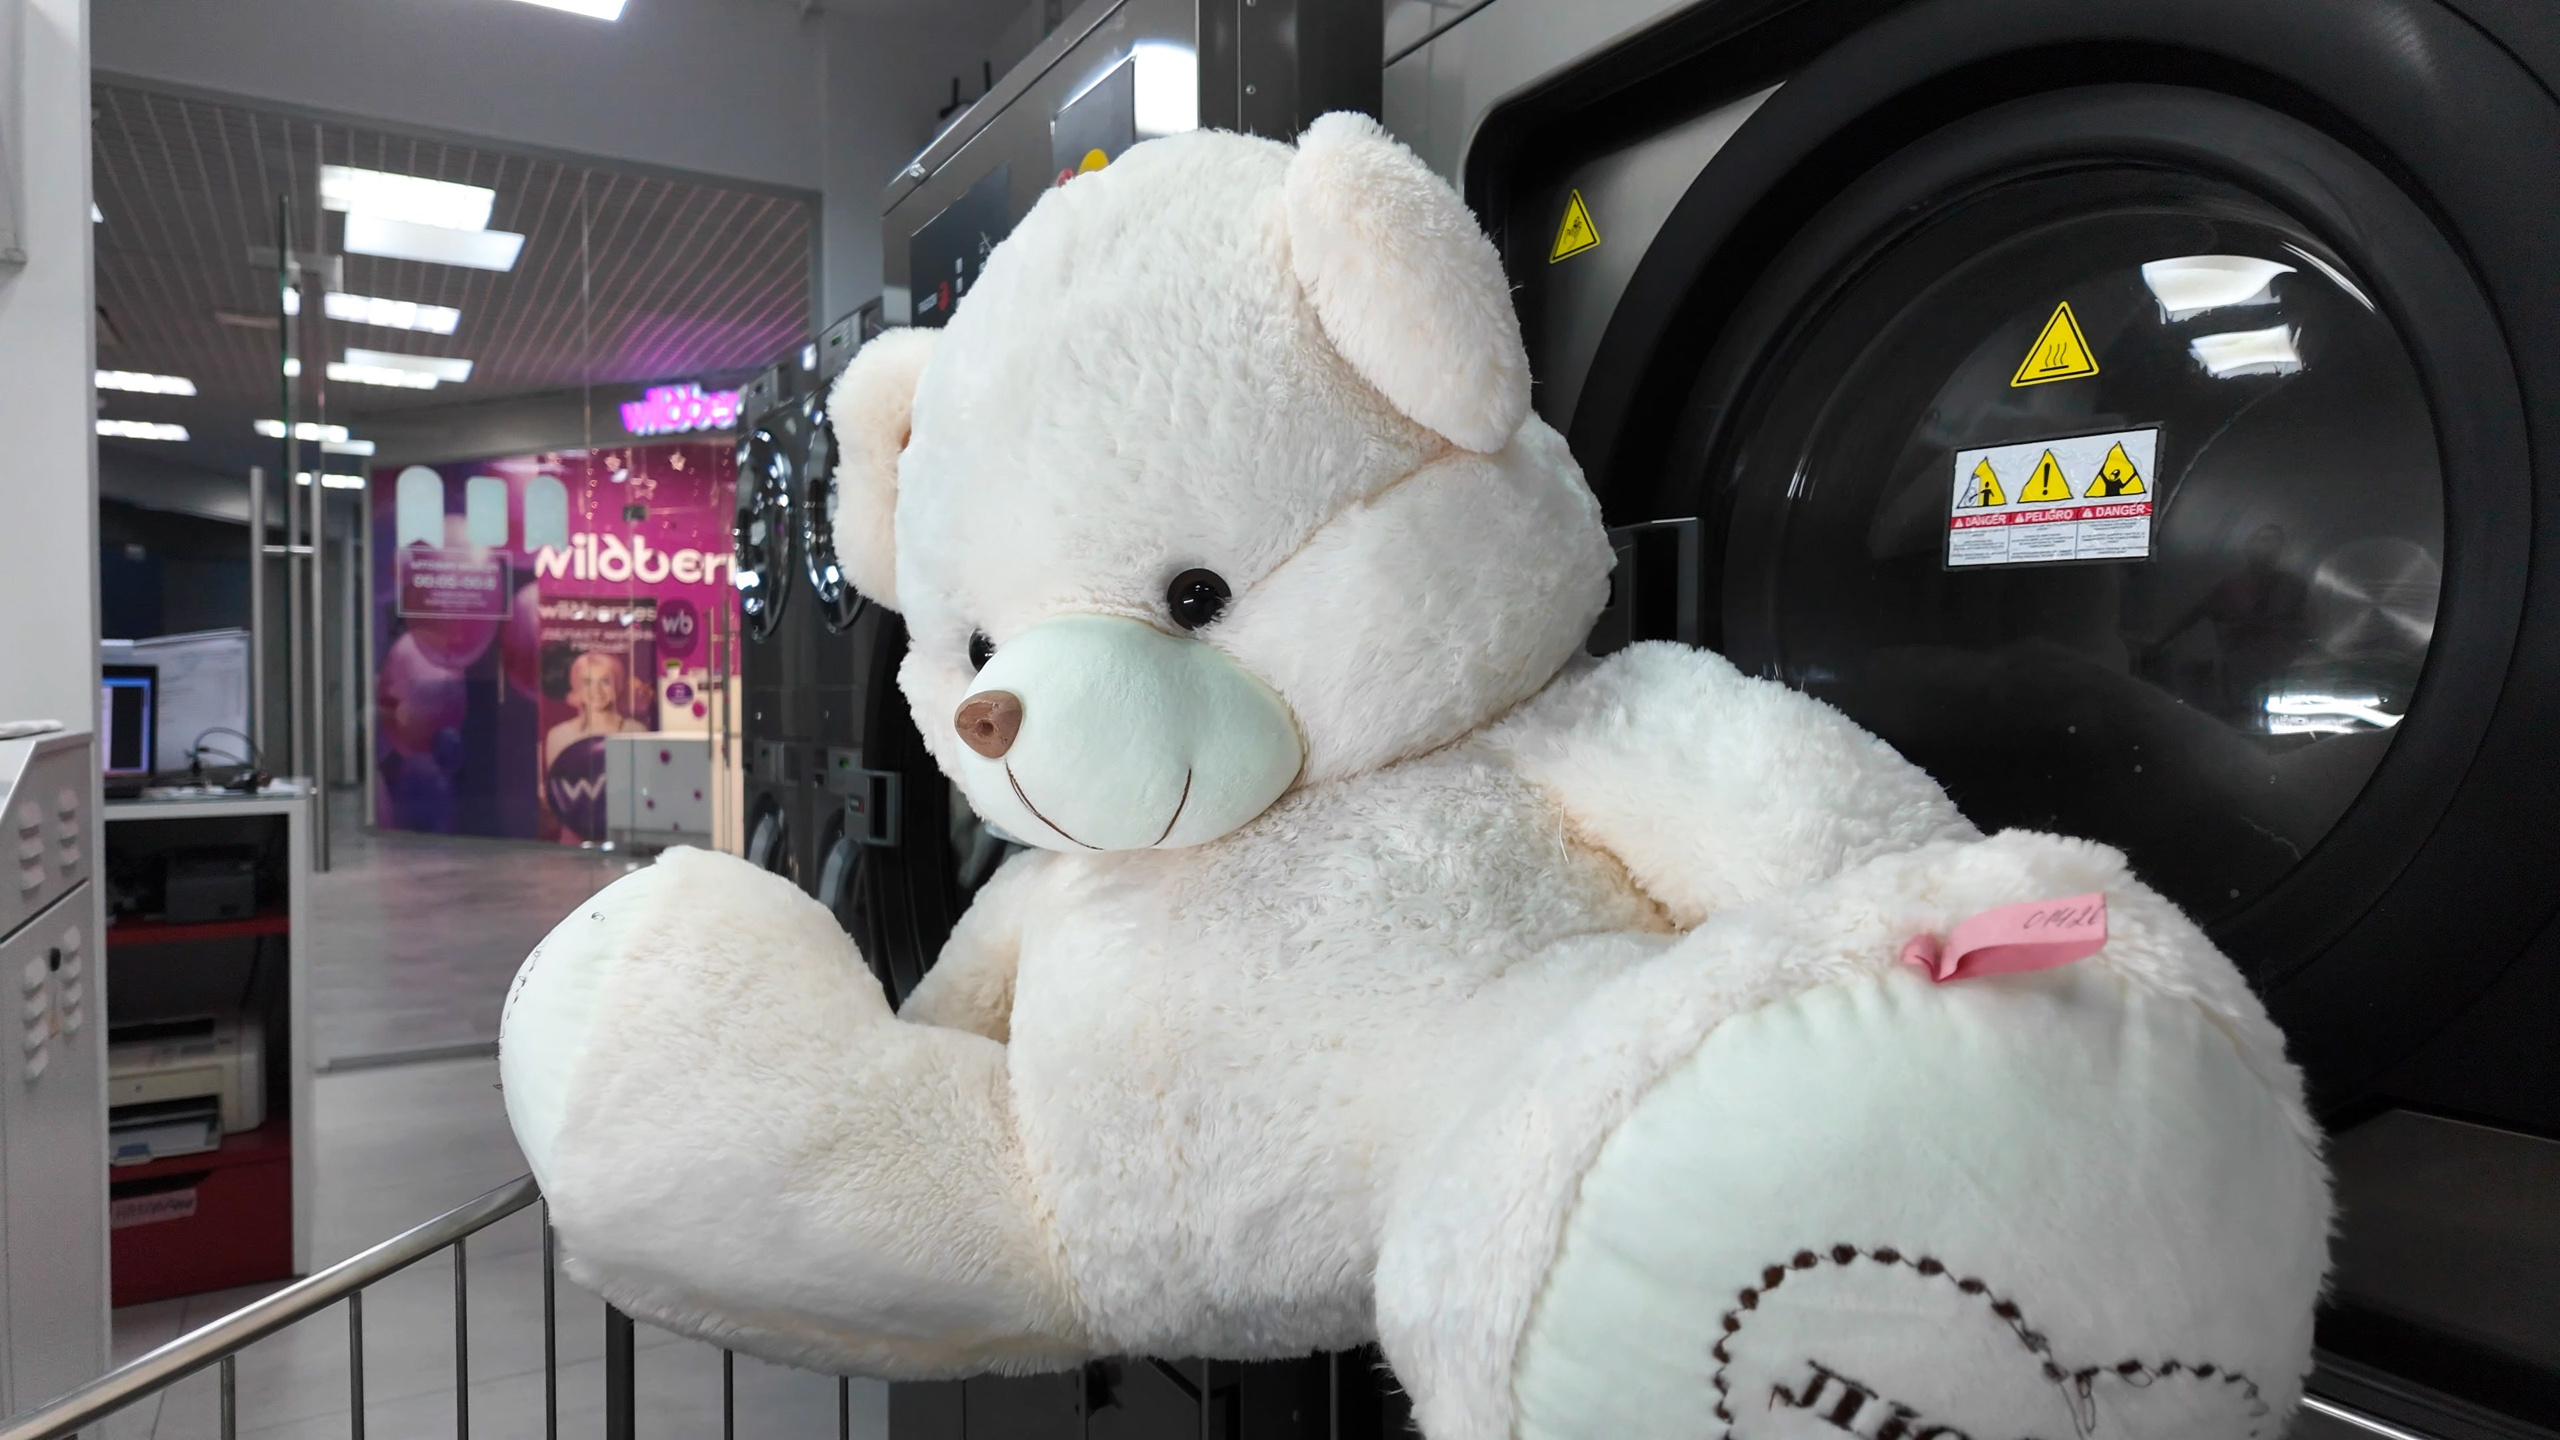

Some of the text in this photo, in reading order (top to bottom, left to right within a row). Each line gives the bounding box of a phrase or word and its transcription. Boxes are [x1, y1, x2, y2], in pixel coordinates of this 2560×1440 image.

[2024, 508, 2074, 524] PELIGRO
[2095, 503, 2146, 518] DANGER
[1964, 513, 2007, 528] DANGER
